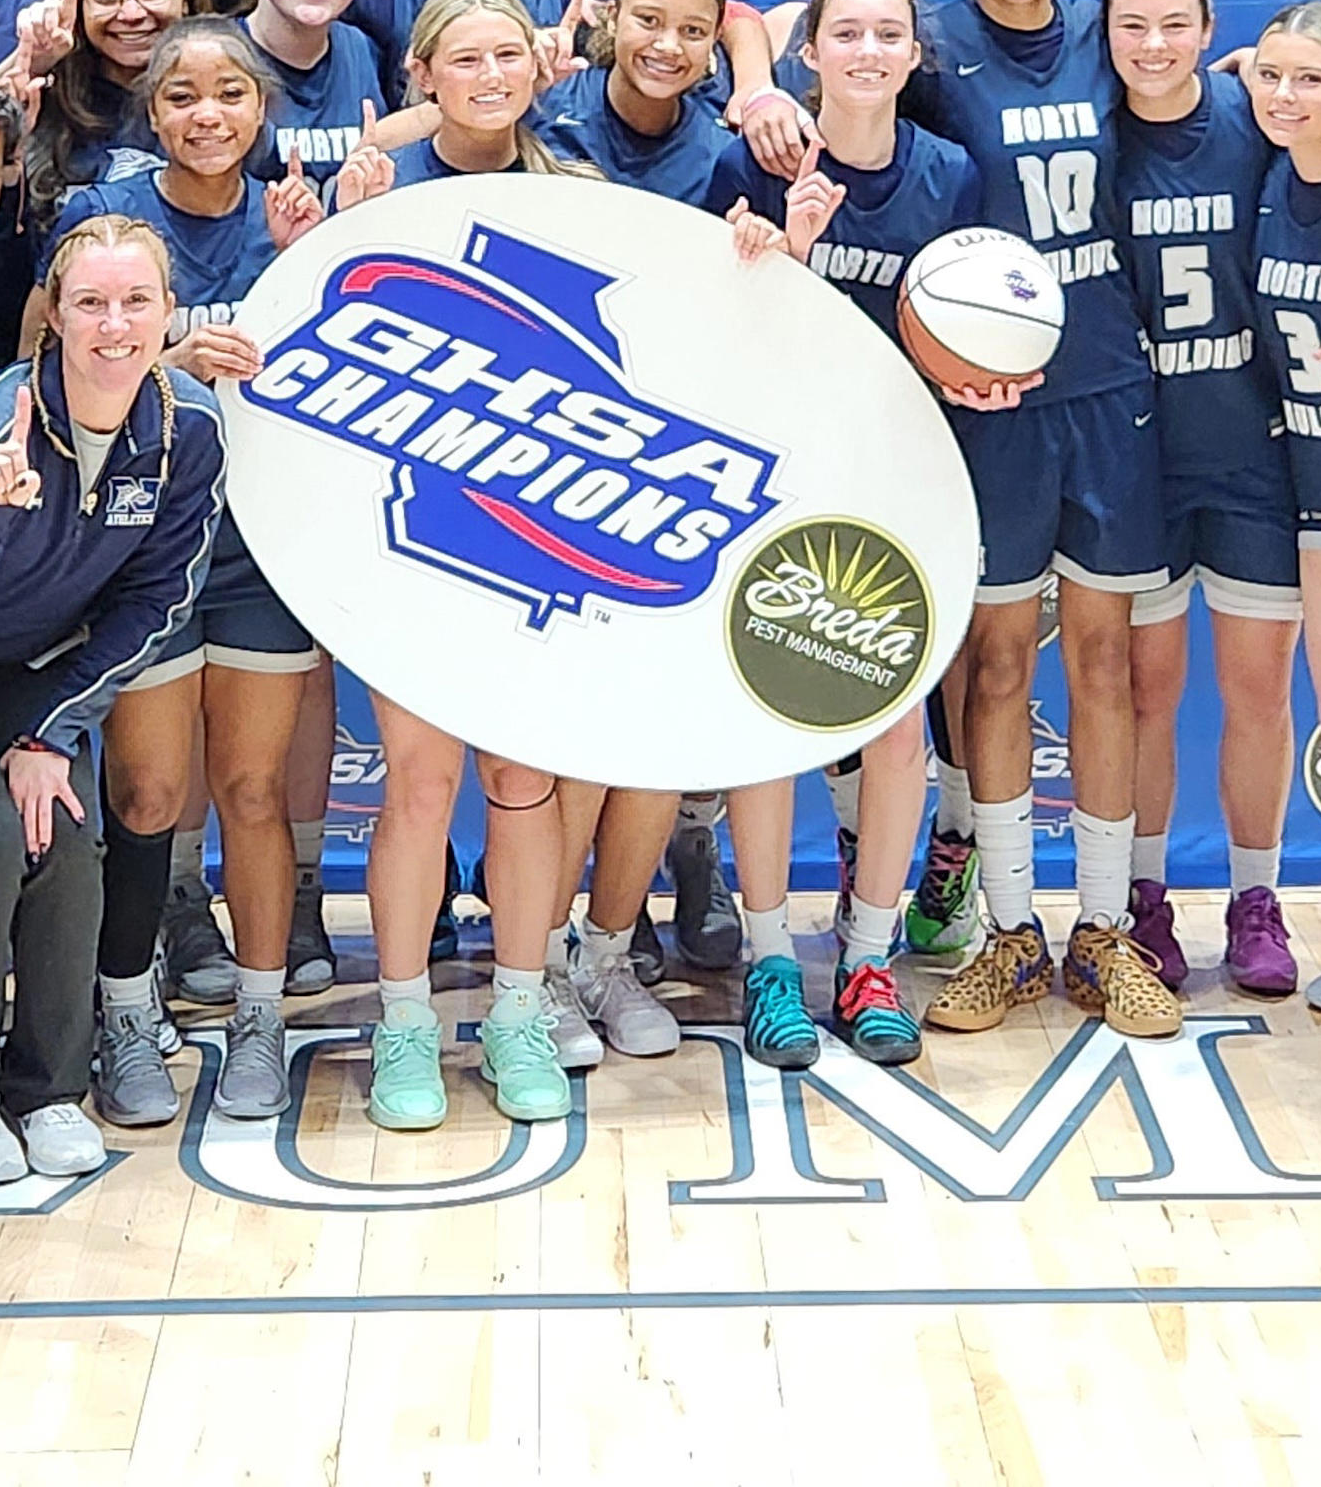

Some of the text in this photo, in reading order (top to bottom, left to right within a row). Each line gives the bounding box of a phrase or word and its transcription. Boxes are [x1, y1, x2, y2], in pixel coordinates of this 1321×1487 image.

[1001, 102, 1099, 146] NORTH
[1016, 150, 1098, 241] 10
[1131, 194, 1234, 236] NORTH
[809, 242, 904, 287] NORTH
[1161, 244, 1215, 331] 5
[313, 300, 768, 515] GHSA
[251, 347, 732, 563] CHAMPIONS
[745, 561, 916, 665] Breda
[745, 614, 897, 688] PEST MANAGEMENT
